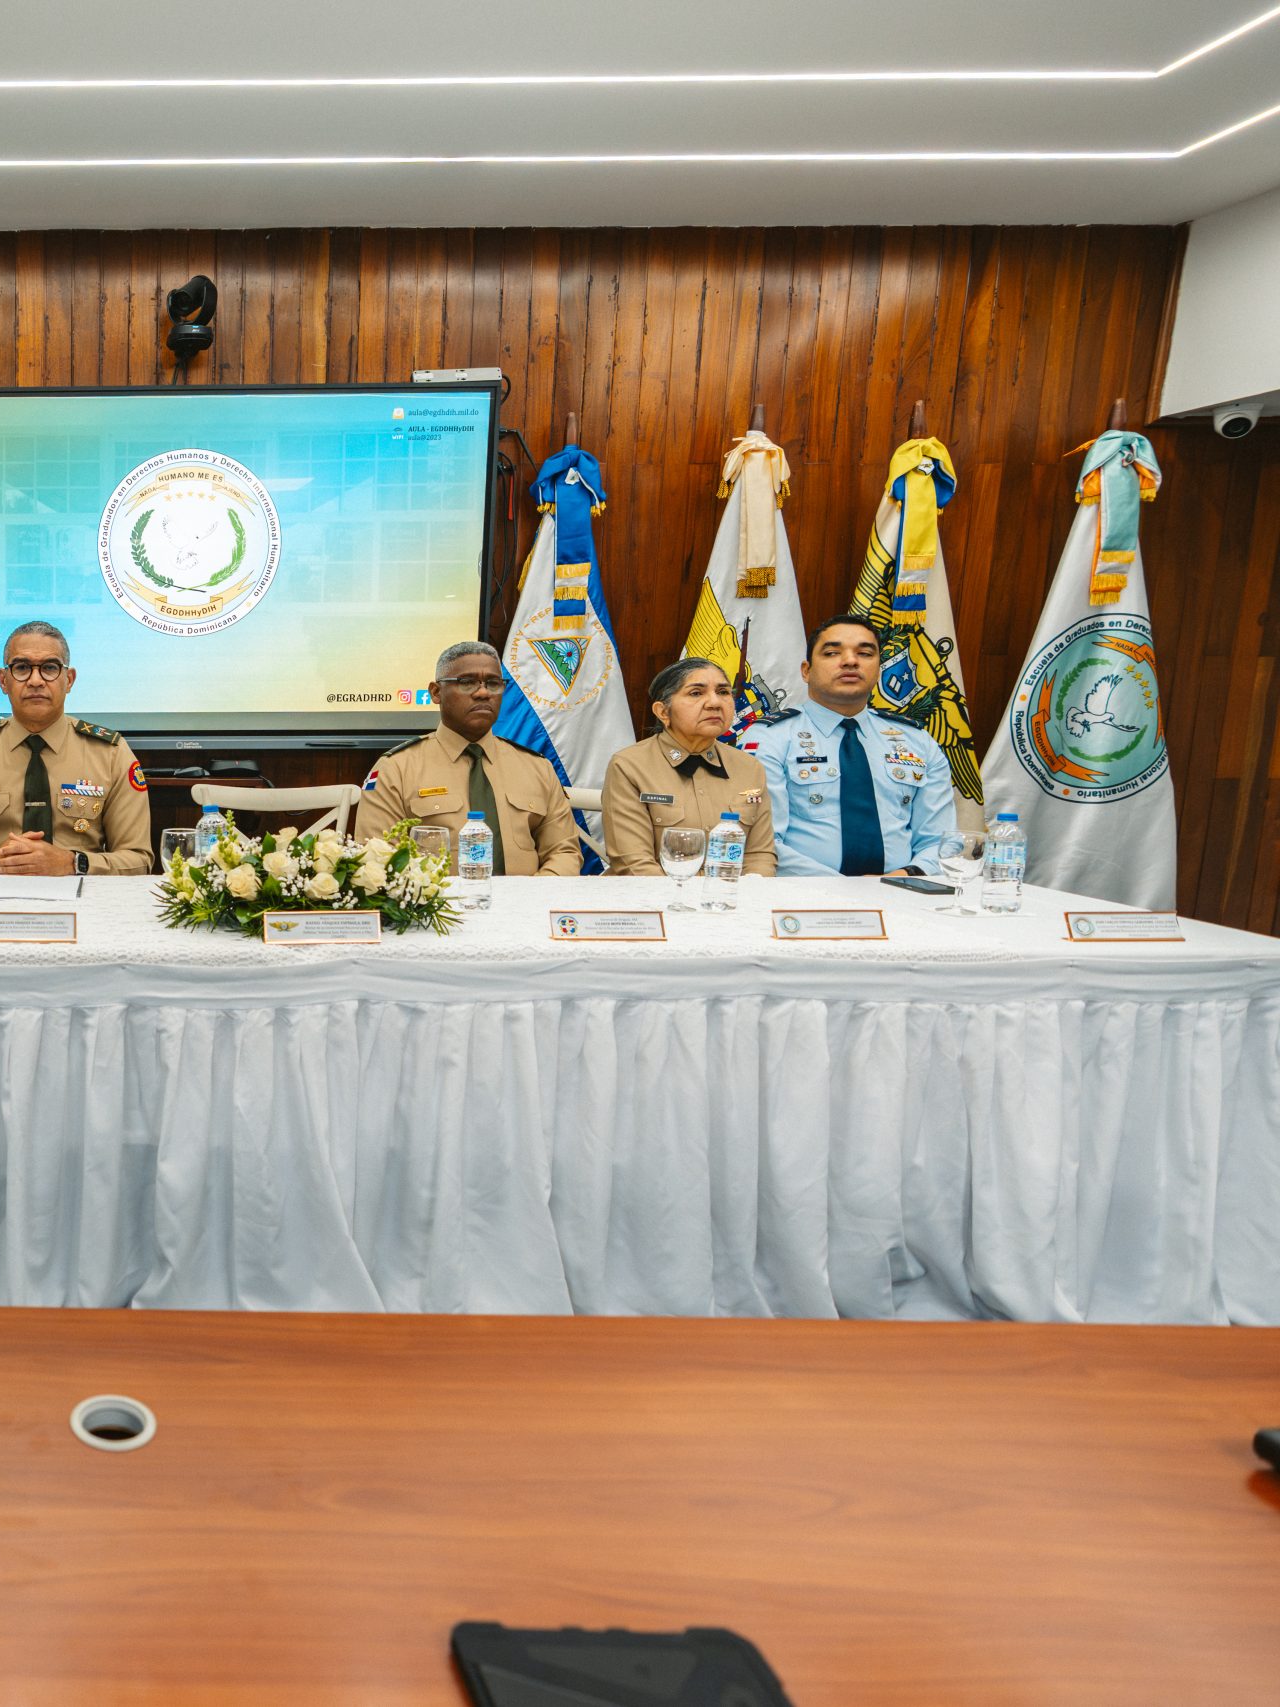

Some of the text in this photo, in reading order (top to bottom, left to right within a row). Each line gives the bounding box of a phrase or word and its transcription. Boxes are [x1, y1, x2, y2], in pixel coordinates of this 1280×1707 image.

[166, 452, 209, 462] Humanos
[126, 458, 164, 485] Derechos
[158, 472, 224, 482] HUMANO ME ES
[220, 457, 252, 483] Derecho
[118, 487, 127, 497] en
[100, 498, 119, 548] Graduados
[252, 482, 278, 541] Internacional
[102, 550, 109, 562] de
[106, 564, 124, 599] Escuela
[254, 544, 278, 597] Humanitario
[160, 605, 217, 616] EGDDHHyDIH
[142, 614, 238, 634] República Dominicana
[1024, 652, 1052, 686] Escuela
[1054, 642, 1064, 654] de
[1065, 620, 1105, 644] Graduados
[1125, 620, 1152, 636] Derec
[326, 694, 392, 702] @EGRADHRD
[1016, 710, 1054, 790] República Dominicana
[1077, 780, 1139, 798] Humanitario
